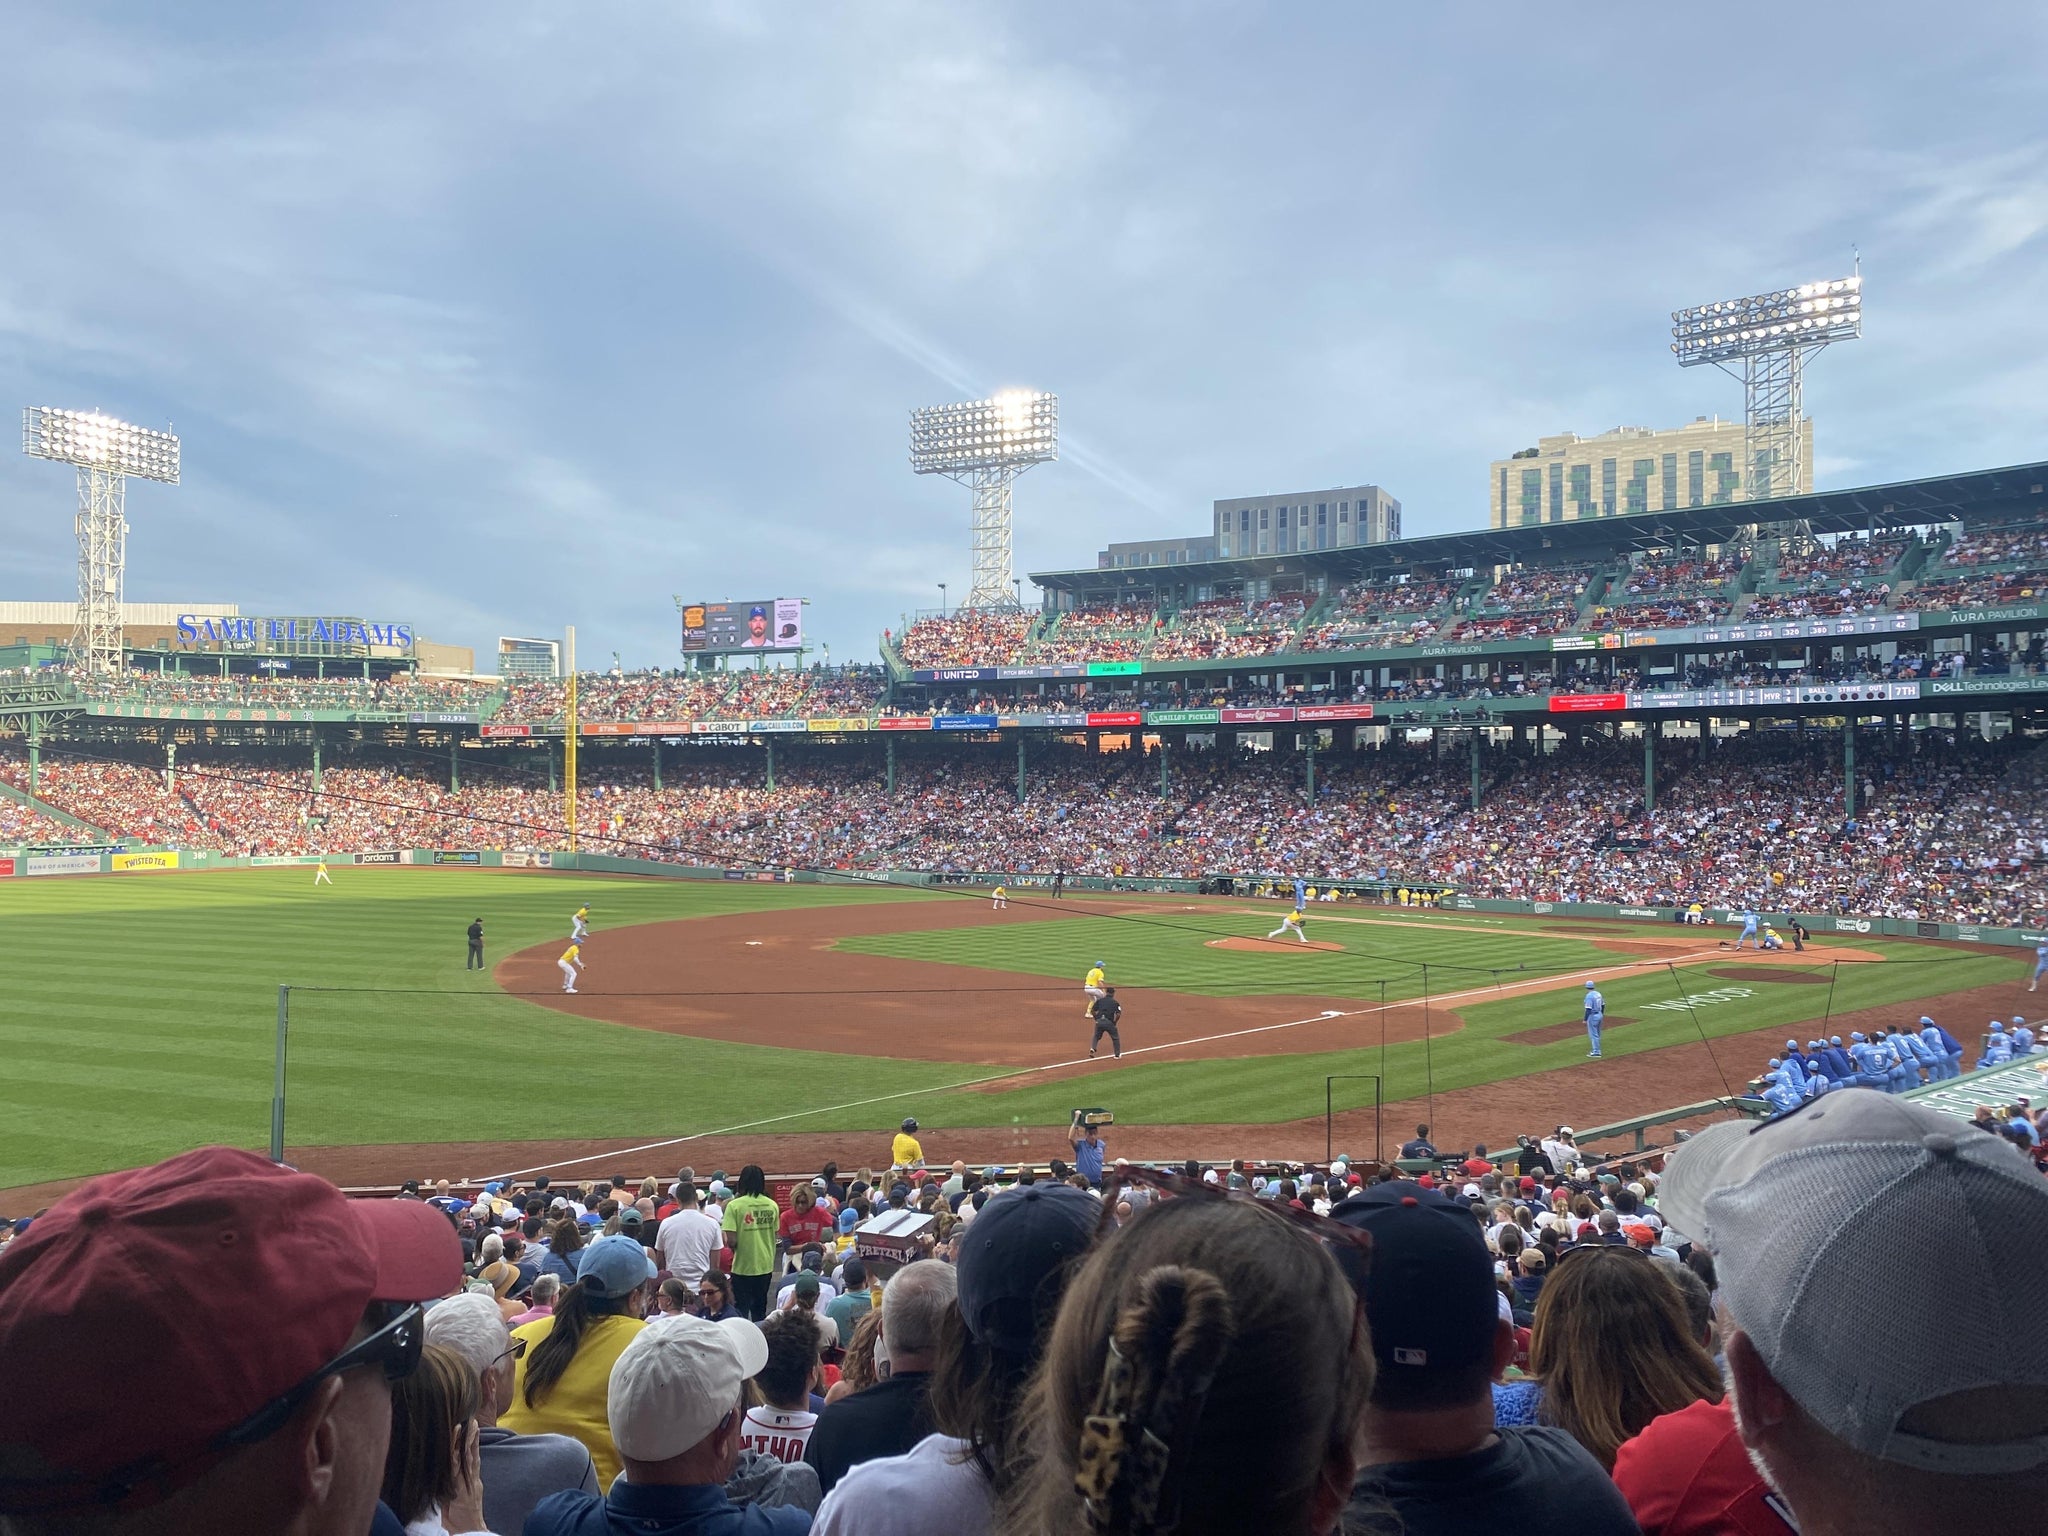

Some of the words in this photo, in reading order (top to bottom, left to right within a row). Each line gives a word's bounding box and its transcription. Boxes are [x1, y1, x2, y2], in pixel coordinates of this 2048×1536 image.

[1987, 608, 2038, 620] PAVILION
[177, 614, 305, 643] SAMUEL
[309, 617, 412, 648] ADAMS
[1630, 637, 1657, 645] LOFTIN
[1447, 645, 1482, 654] PAVILION
[944, 670, 979, 680] UNITED
[1963, 680, 2029, 691] Technologies
[1896, 687, 1916, 696] 7TH
[114, 706, 122, 715] 4
[130, 706, 135, 717] 1
[203, 709, 216, 720] 14
[226, 709, 242, 720] 45
[302, 710, 314, 720] 42
[1266, 711, 1280, 719] Nine
[1300, 709, 1335, 718] Safelite
[1188, 712, 1216, 720] PICKLES
[504, 727, 523, 735] PIZZA
[193, 852, 206, 860] 380
[124, 858, 153, 869] TWISTED
[153, 858, 166, 867] TEA
[1619, 908, 1658, 917] smartwater
[1836, 923, 1856, 931] Nine
[1874, 1054, 1882, 1066] 9
[859, 1245, 905, 1263] PRETZEL
[740, 1435, 804, 1464] NTHO
